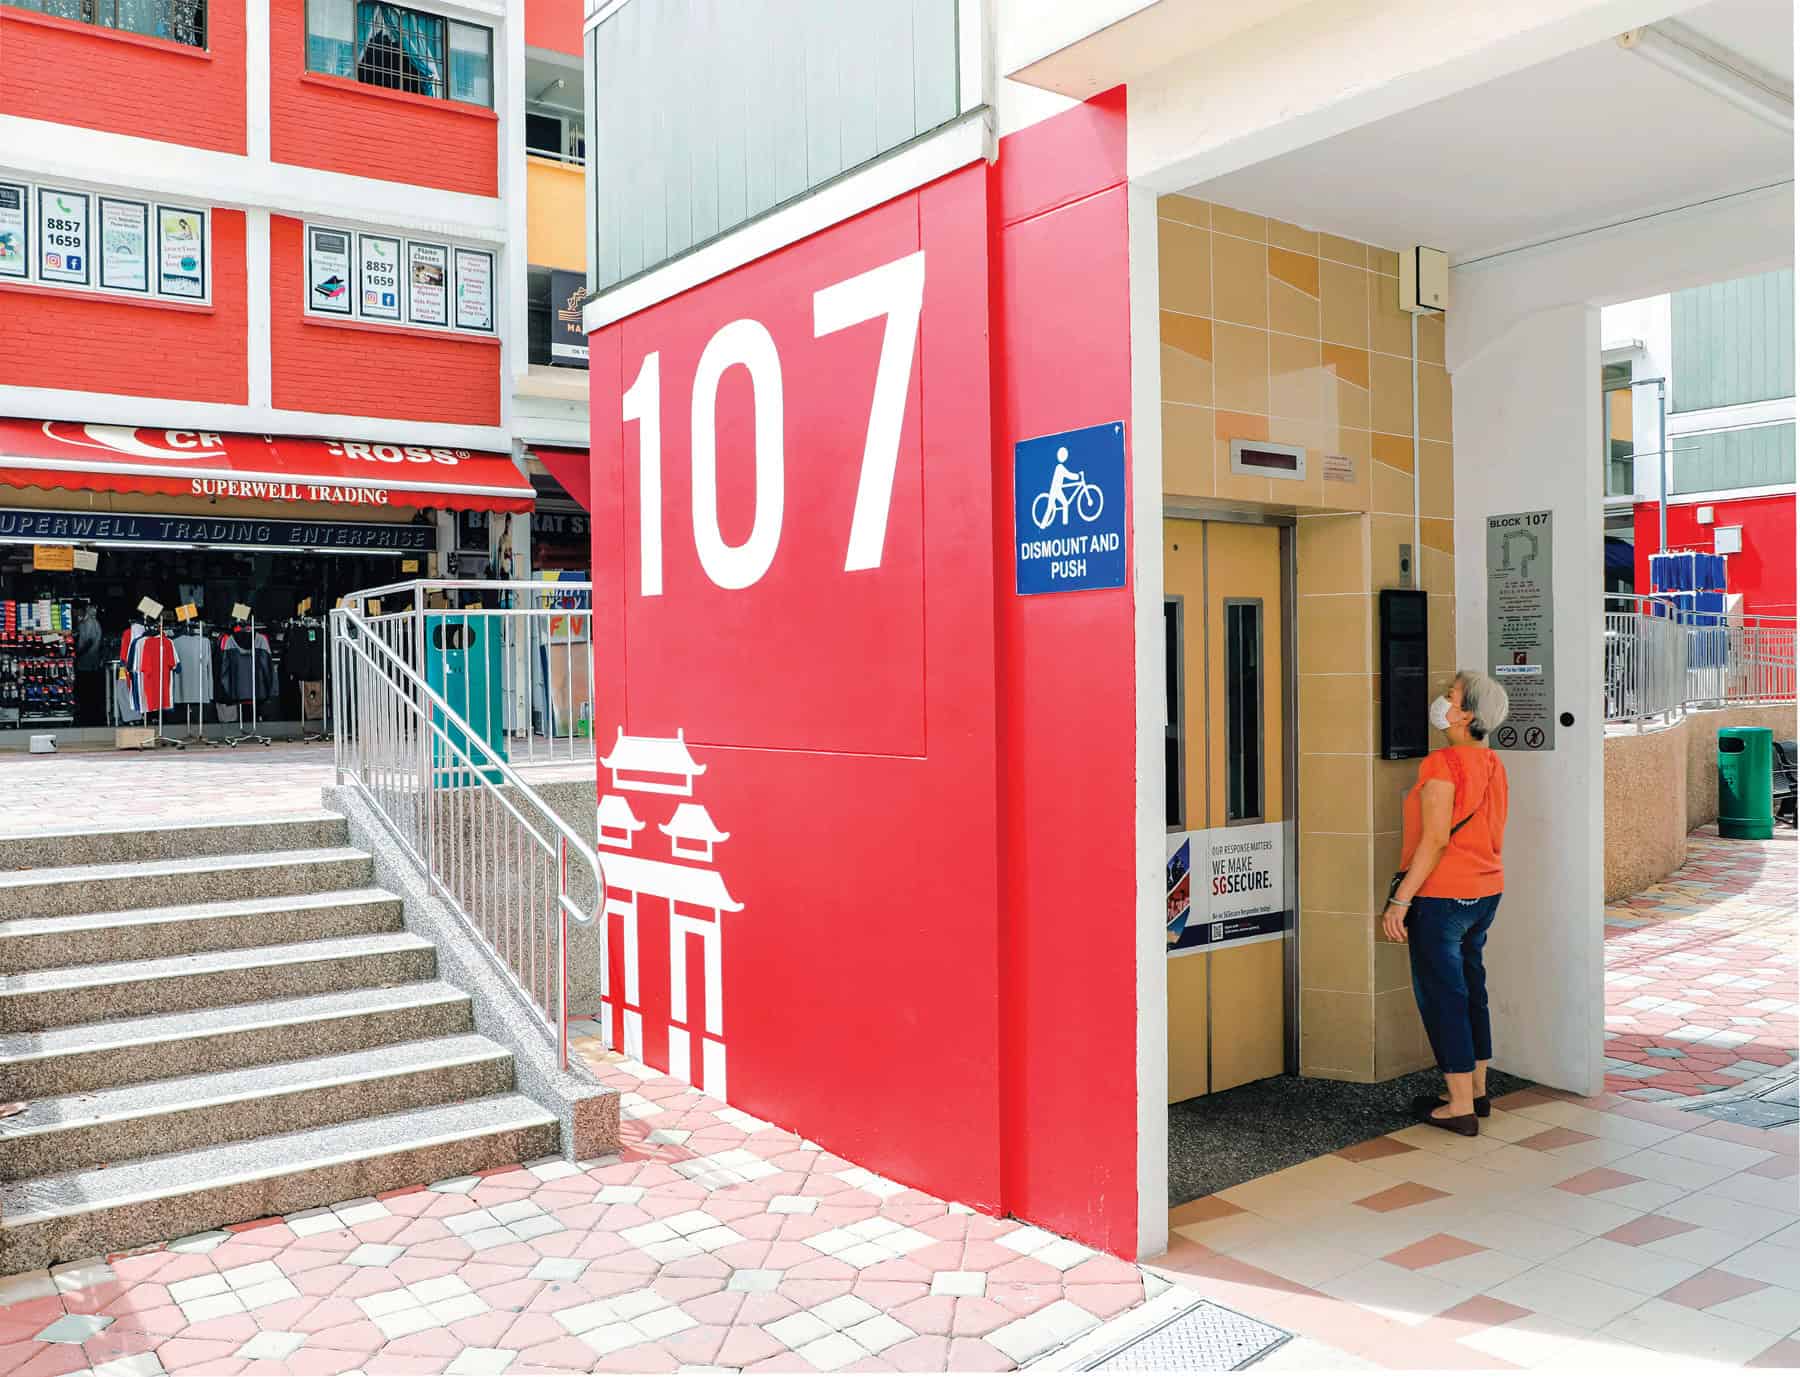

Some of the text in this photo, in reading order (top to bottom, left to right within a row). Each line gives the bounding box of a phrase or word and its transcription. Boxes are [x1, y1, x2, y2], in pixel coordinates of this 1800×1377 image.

[47, 218, 81, 233] 8857
[48, 233, 81, 248] 1659
[366, 260, 394, 274] 8857
[367, 274, 394, 287] 1659
[622, 249, 926, 597] 107
[191, 478, 388, 504] SUPERWELL TRADING
[1489, 513, 1548, 528] BLOCK 107
[160, 521, 271, 542] TRADING
[288, 526, 425, 547] ENTERPRISE
[1021, 532, 1120, 561] DISMOUNT AND
[1051, 559, 1087, 580] PUSH
[1224, 842, 1250, 855] RESPONSE
[1212, 856, 1252, 875] WE MAKE
[1212, 870, 1273, 896] SGSECURE.
